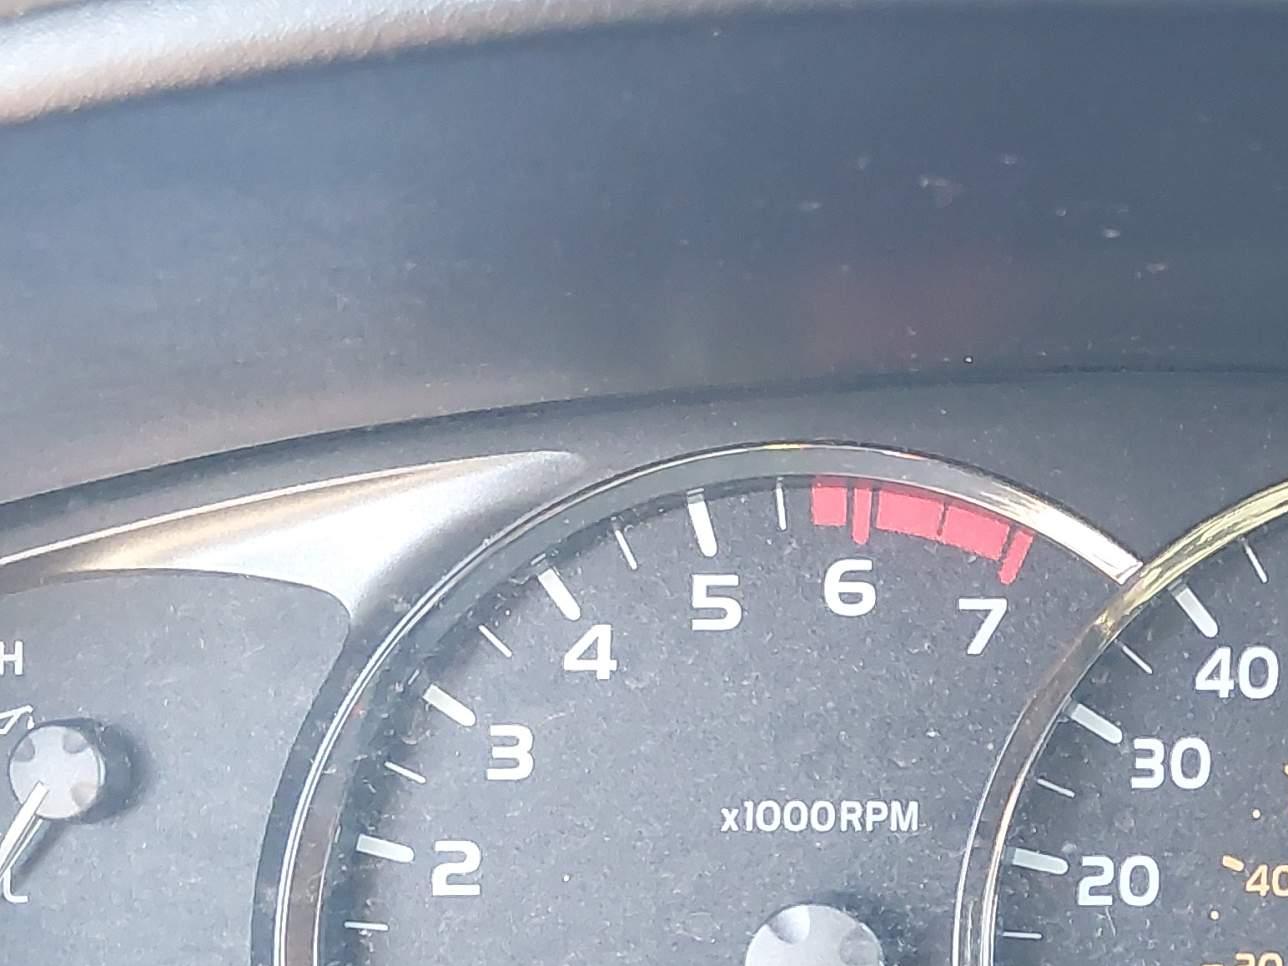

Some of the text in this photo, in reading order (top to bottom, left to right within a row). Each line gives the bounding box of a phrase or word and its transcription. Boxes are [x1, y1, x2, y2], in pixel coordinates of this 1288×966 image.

[691, 574, 743, 631] 5
[824, 559, 876, 616] 6
[563, 624, 618, 680] 4
[957, 598, 1009, 655] 7
[1194, 646, 1280, 699] 40
[486, 725, 535, 780] 3
[1130, 737, 1212, 789] 30
[431, 841, 481, 897] 2
[1076, 855, 1160, 906] 20
